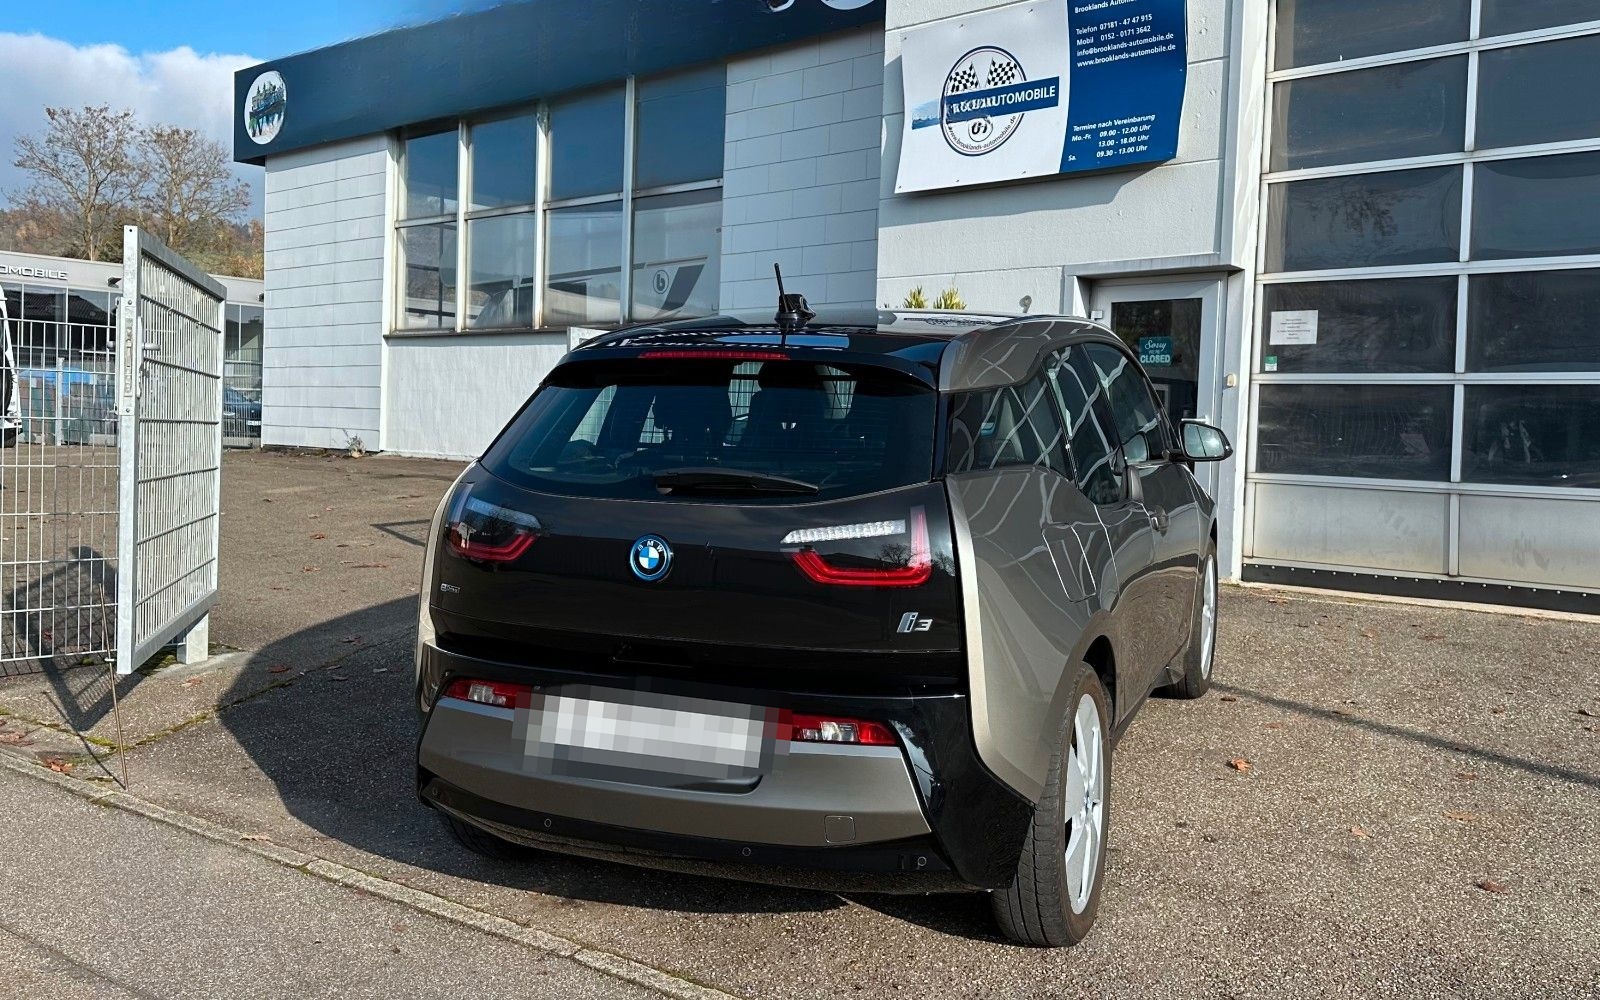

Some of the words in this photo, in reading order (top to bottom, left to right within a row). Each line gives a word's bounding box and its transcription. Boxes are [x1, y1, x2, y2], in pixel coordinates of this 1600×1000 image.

[1074, 1, 1109, 14] Brooklands
[1076, 26, 1098, 35] Telefon
[1099, 20, 1118, 31] 07181
[1122, 18, 1131, 26] 47
[1131, 16, 1141, 24] 47
[1140, 13, 1153, 22] 915
[1076, 36, 1094, 46] Mobil
[1100, 32, 1115, 42] 0152
[1119, 29, 1135, 38] 0171
[1135, 25, 1151, 35] 3642
[1076, 33, 1174, 56] info@brooklands-automobile.de
[1077, 44, 1176, 67] www.brooklands-automobile.de
[1073, 122, 1097, 132] Termine
[1097, 119, 1113, 128] nach
[1113, 114, 1156, 126] Vereinbarung
[1071, 133, 1092, 142] Mo.-Fr.
[1099, 129, 1117, 138] 09.00
[1121, 126, 1139, 135] 12.00
[1139, 124, 1152, 132] Uhr
[1098, 139, 1115, 148] 13.00
[1120, 136, 1137, 145] 18.00
[1137, 134, 1150, 142] Uhr
[1067, 154, 1077, 162] Sa.
[1096, 149, 1114, 158] 09.30
[1118, 146, 1135, 155] 13.00
[1135, 144, 1149, 152] Uhr
[1144, 339, 1167, 352] Sorry
[1140, 354, 1171, 364] CLOSED
[637, 540, 665, 553] BMW
[896, 611, 934, 633] i3
